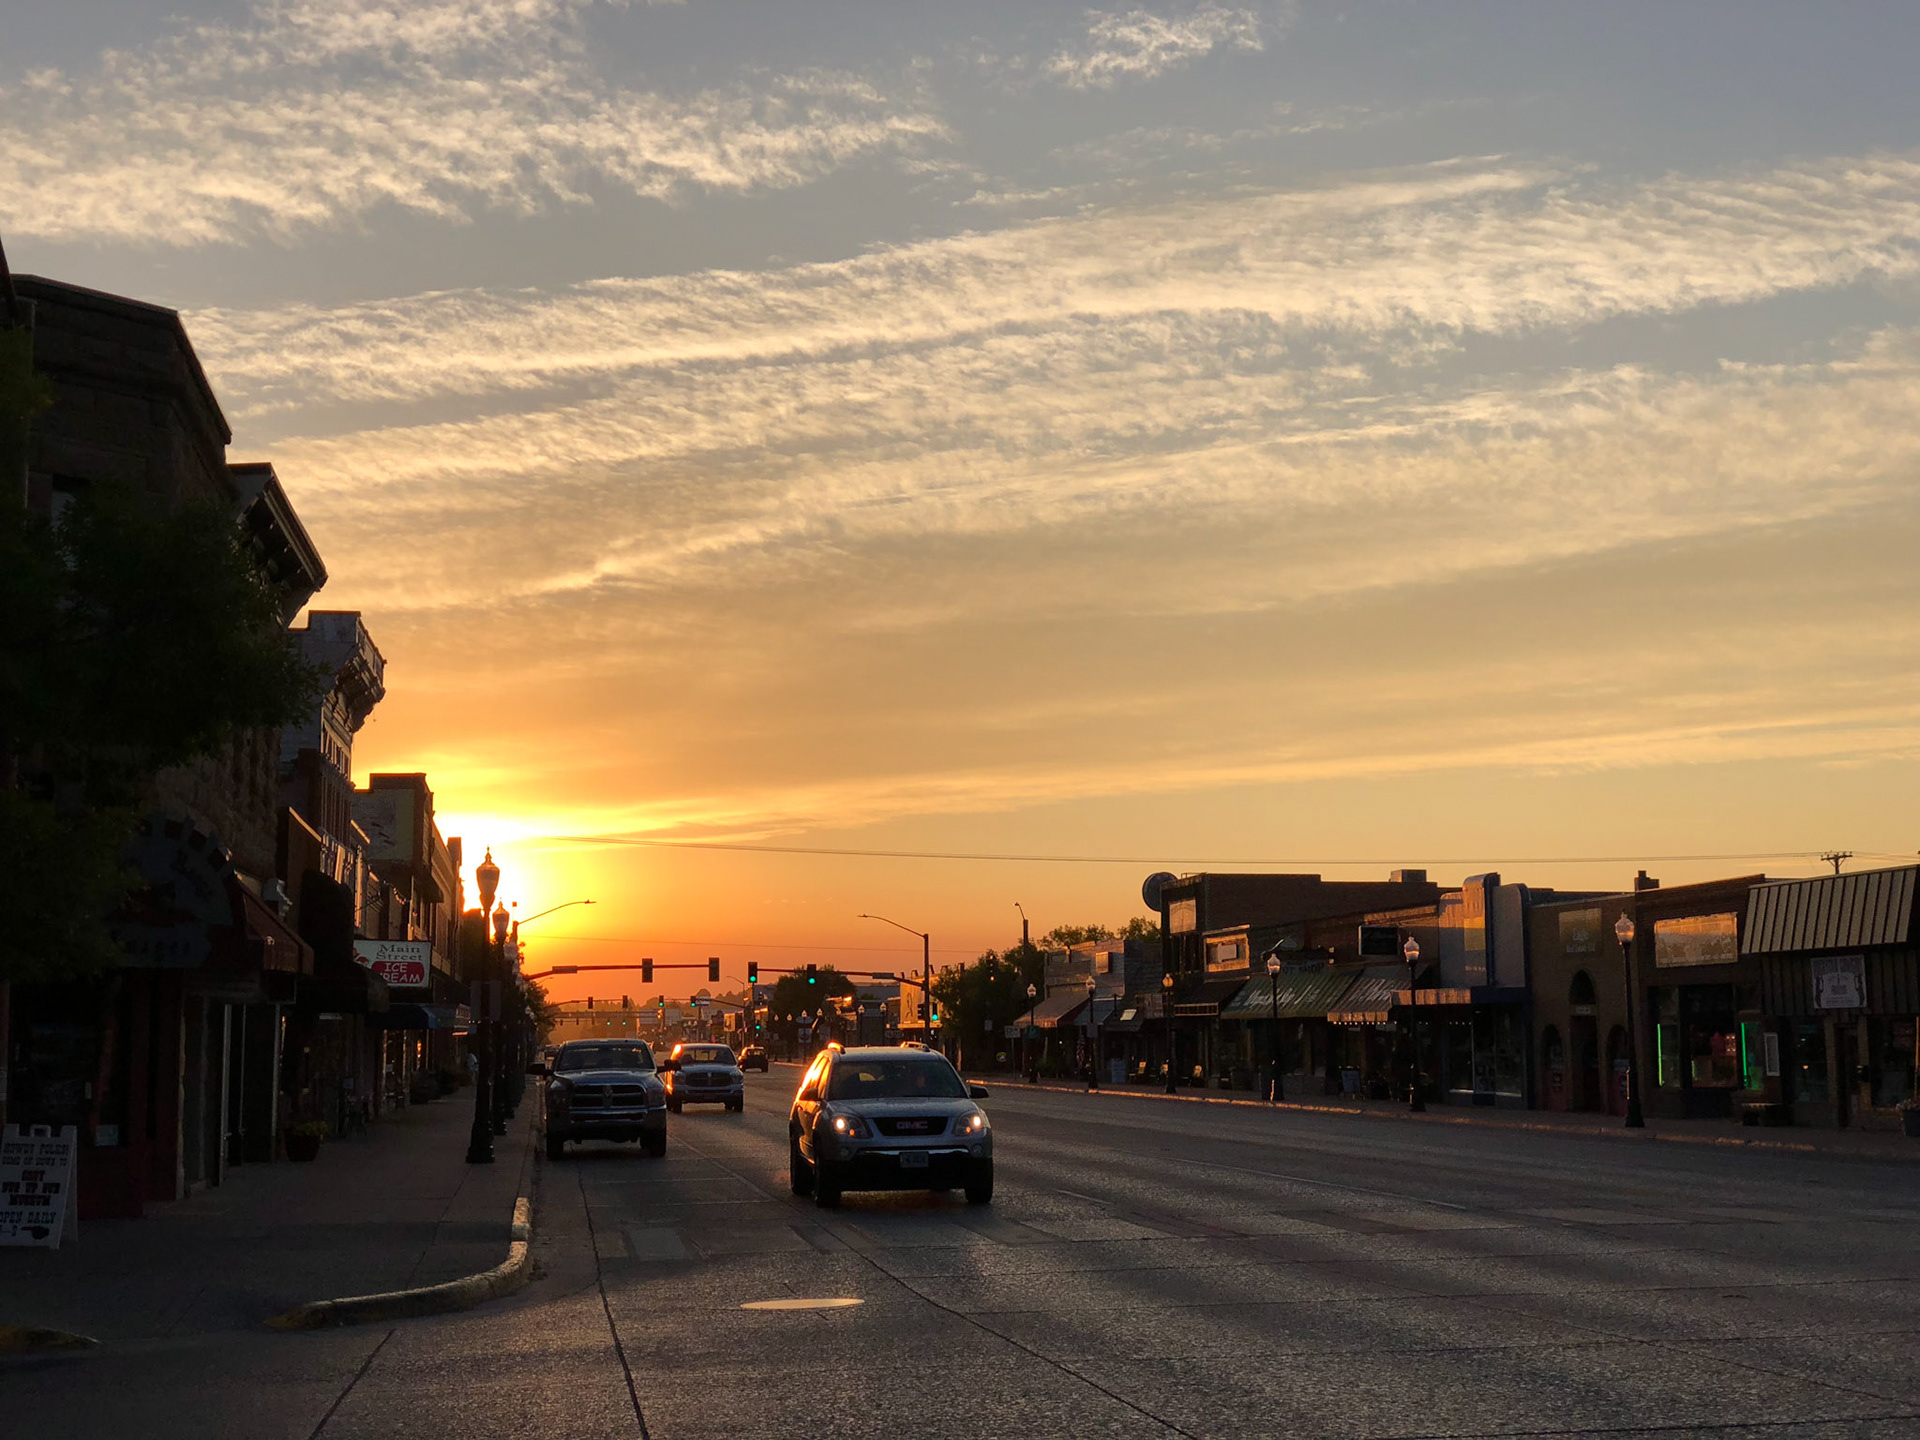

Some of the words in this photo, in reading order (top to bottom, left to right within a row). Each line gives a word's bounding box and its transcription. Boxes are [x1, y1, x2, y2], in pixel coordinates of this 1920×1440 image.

[380, 945, 420, 953] Main
[376, 952, 423, 961] Street
[384, 963, 409, 973] ICE
[380, 972, 420, 983] REAM
[896, 1120, 928, 1130] GMC
[28, 1212, 56, 1224] DAILY
